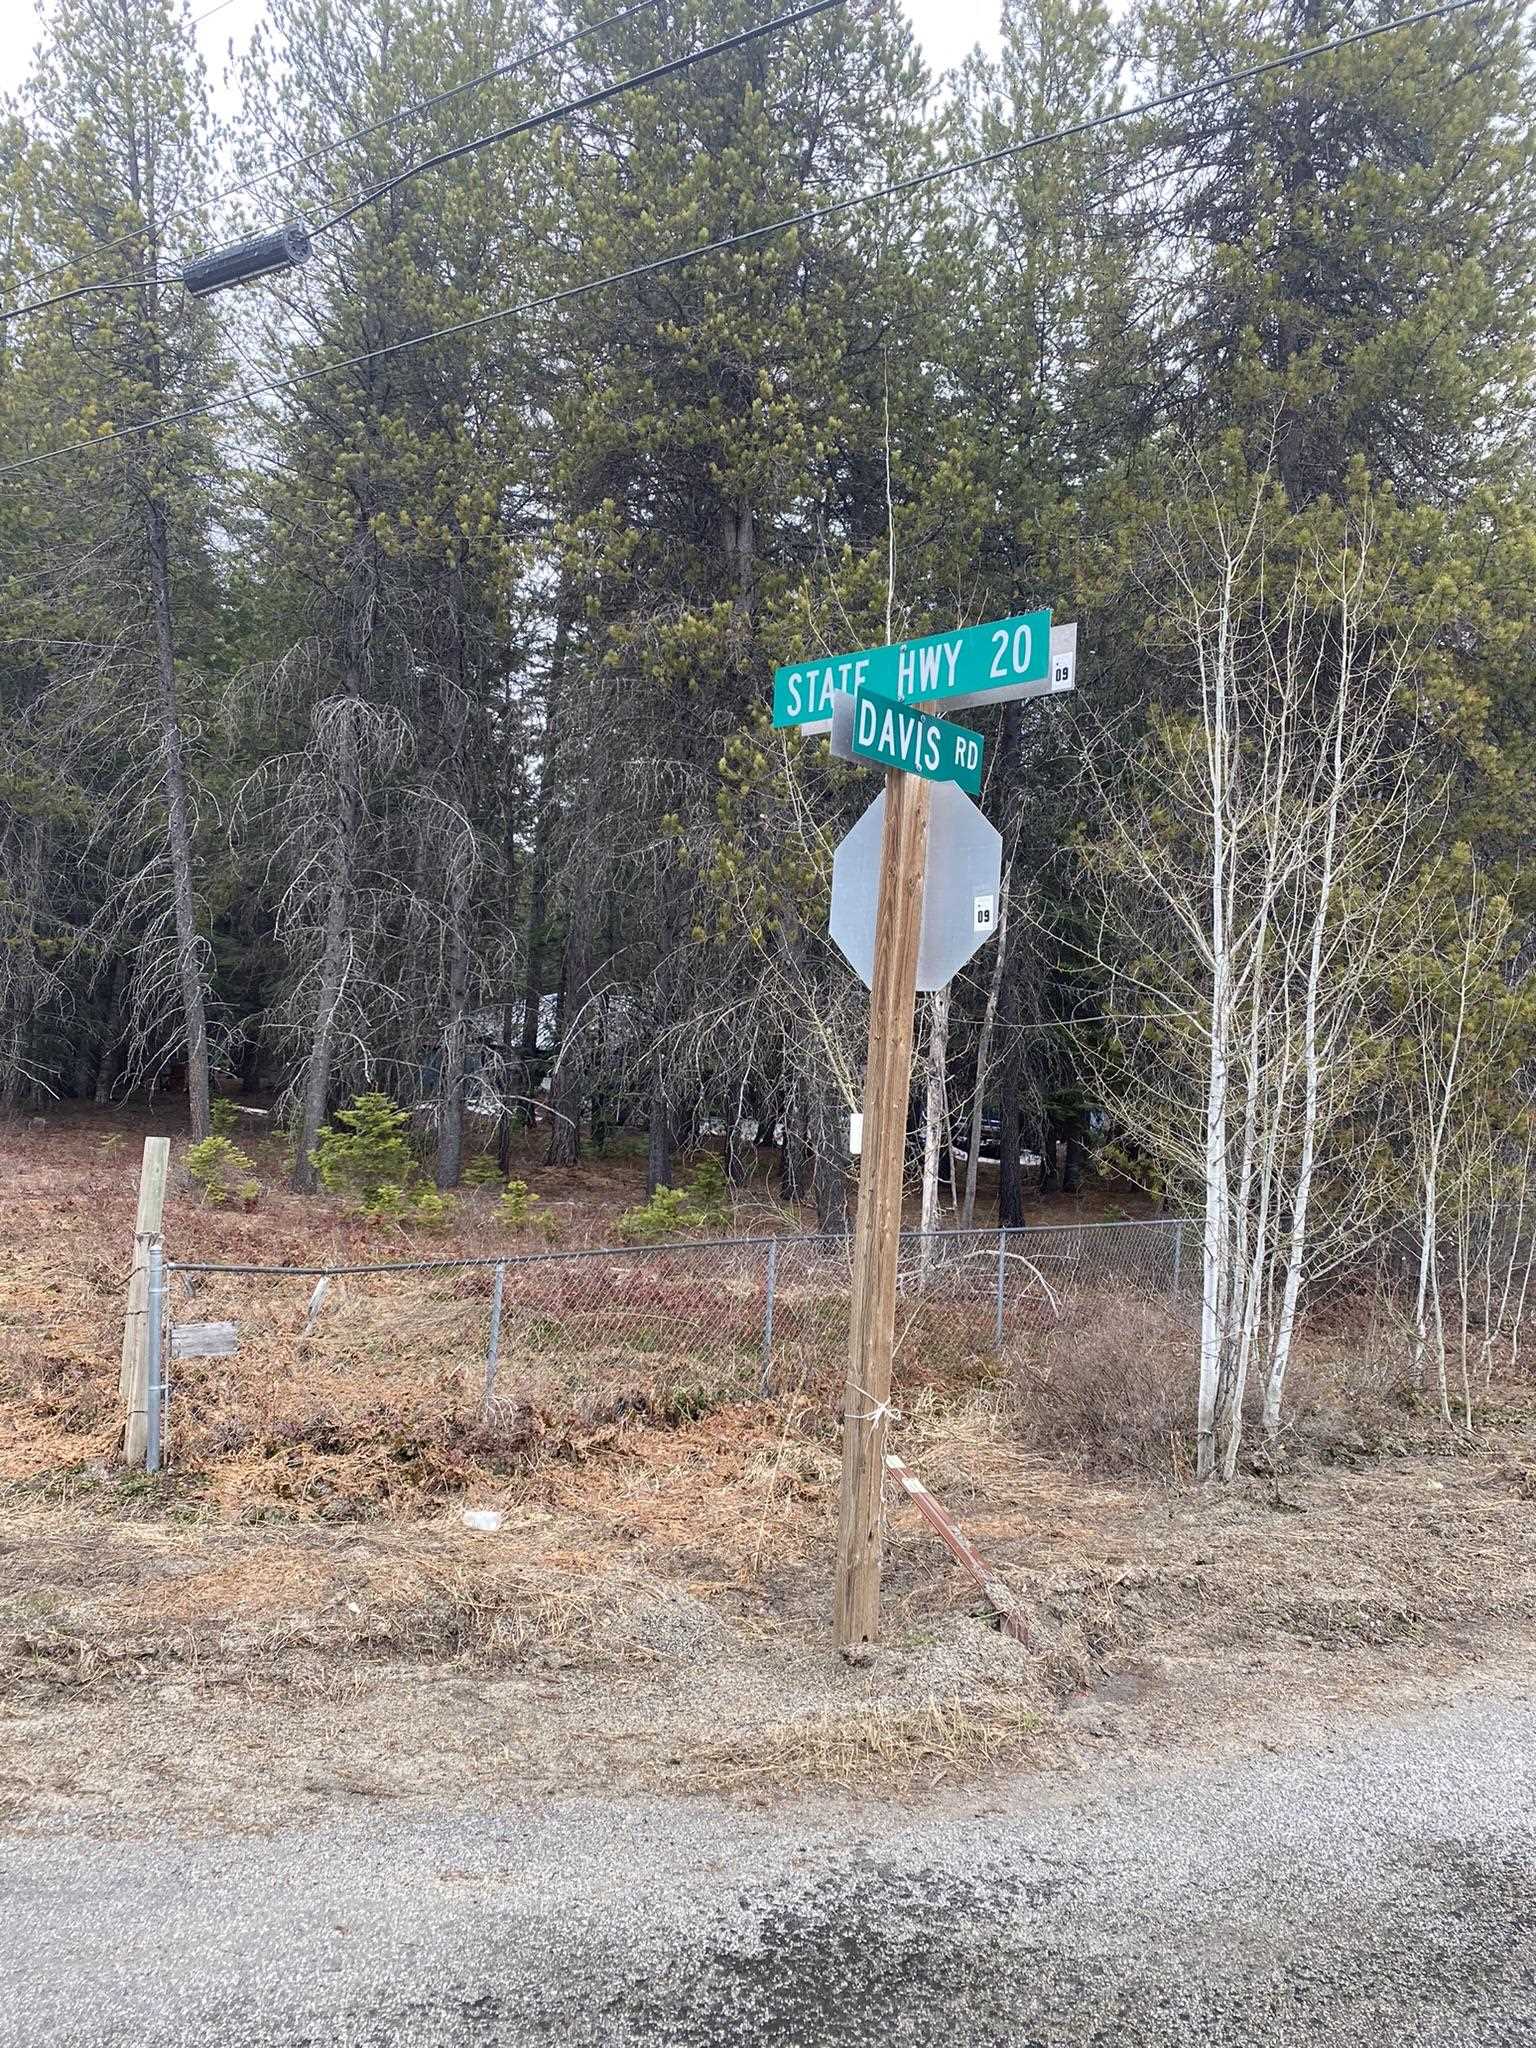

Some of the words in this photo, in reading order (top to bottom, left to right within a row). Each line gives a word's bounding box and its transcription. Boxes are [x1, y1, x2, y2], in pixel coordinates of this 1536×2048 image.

[898, 639, 963, 702] HWY
[989, 623, 1032, 679] 20
[1055, 666, 1069, 682] 09
[858, 698, 941, 772] DAVIS
[954, 735, 978, 771] RD
[977, 909, 990, 923] 09
